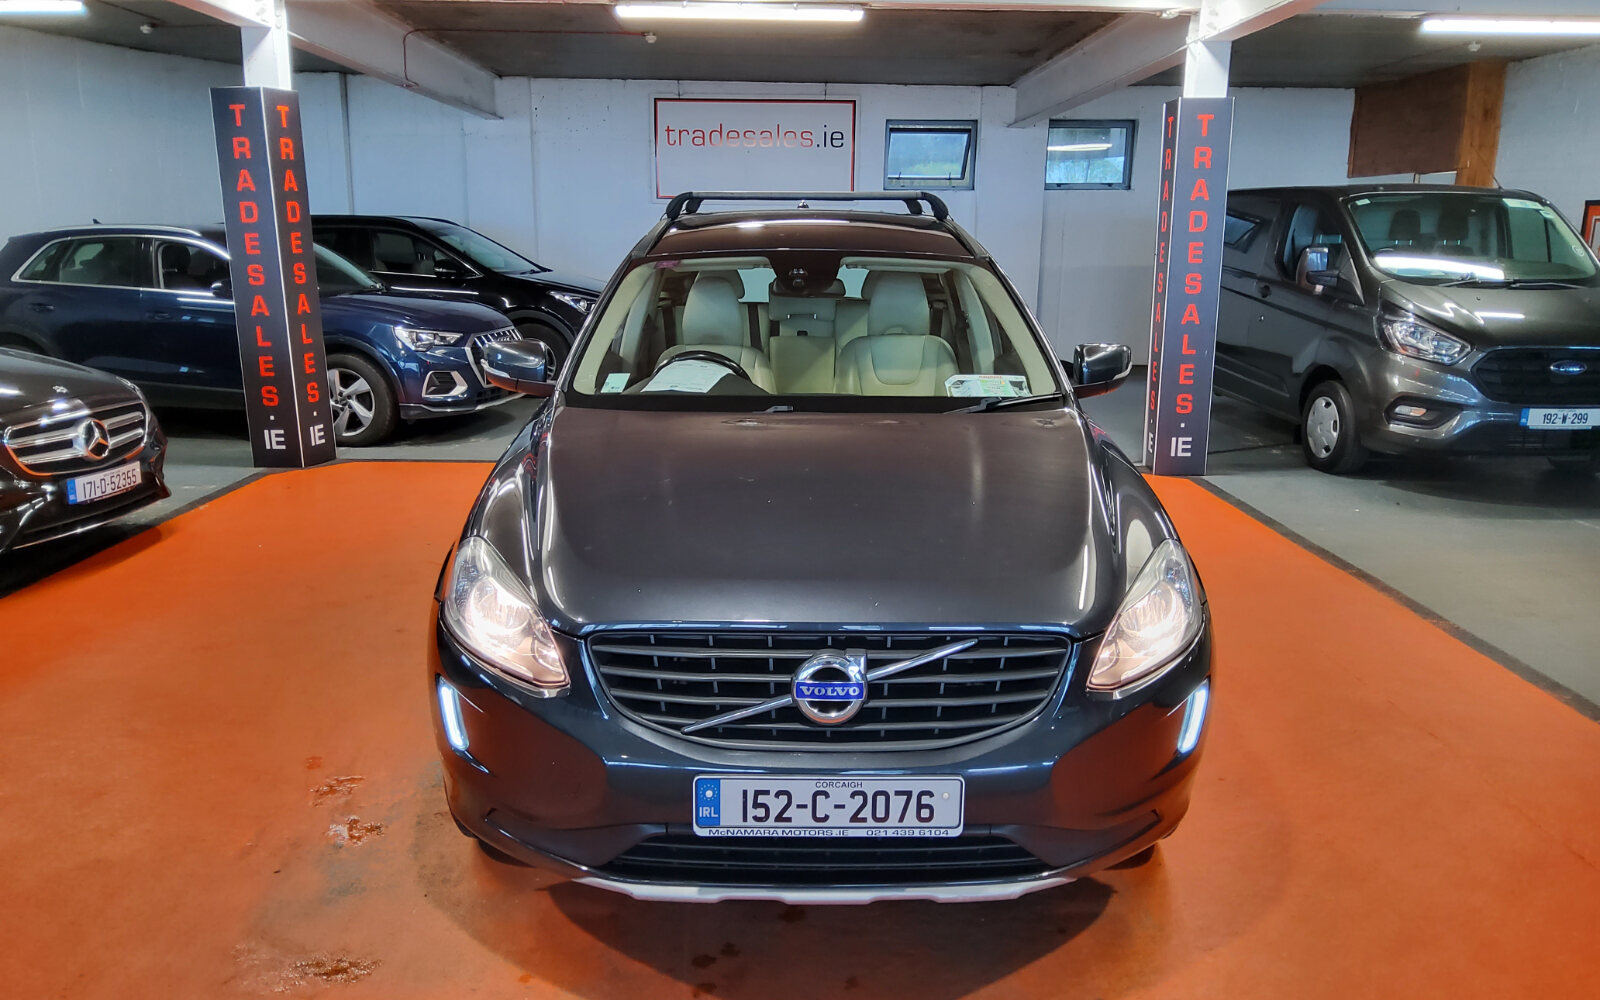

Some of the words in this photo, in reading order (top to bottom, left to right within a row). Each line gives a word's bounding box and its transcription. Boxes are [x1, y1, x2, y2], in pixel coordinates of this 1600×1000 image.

[665, 123, 844, 148] tradesales.ie
[1542, 412, 1589, 425] 192-W-299
[82, 468, 137, 499] 171-D-52355
[799, 685, 860, 696] VOLVO
[815, 781, 863, 789] CORCAIGH
[699, 806, 719, 818] IRL
[742, 789, 935, 824] 152-C-2076
